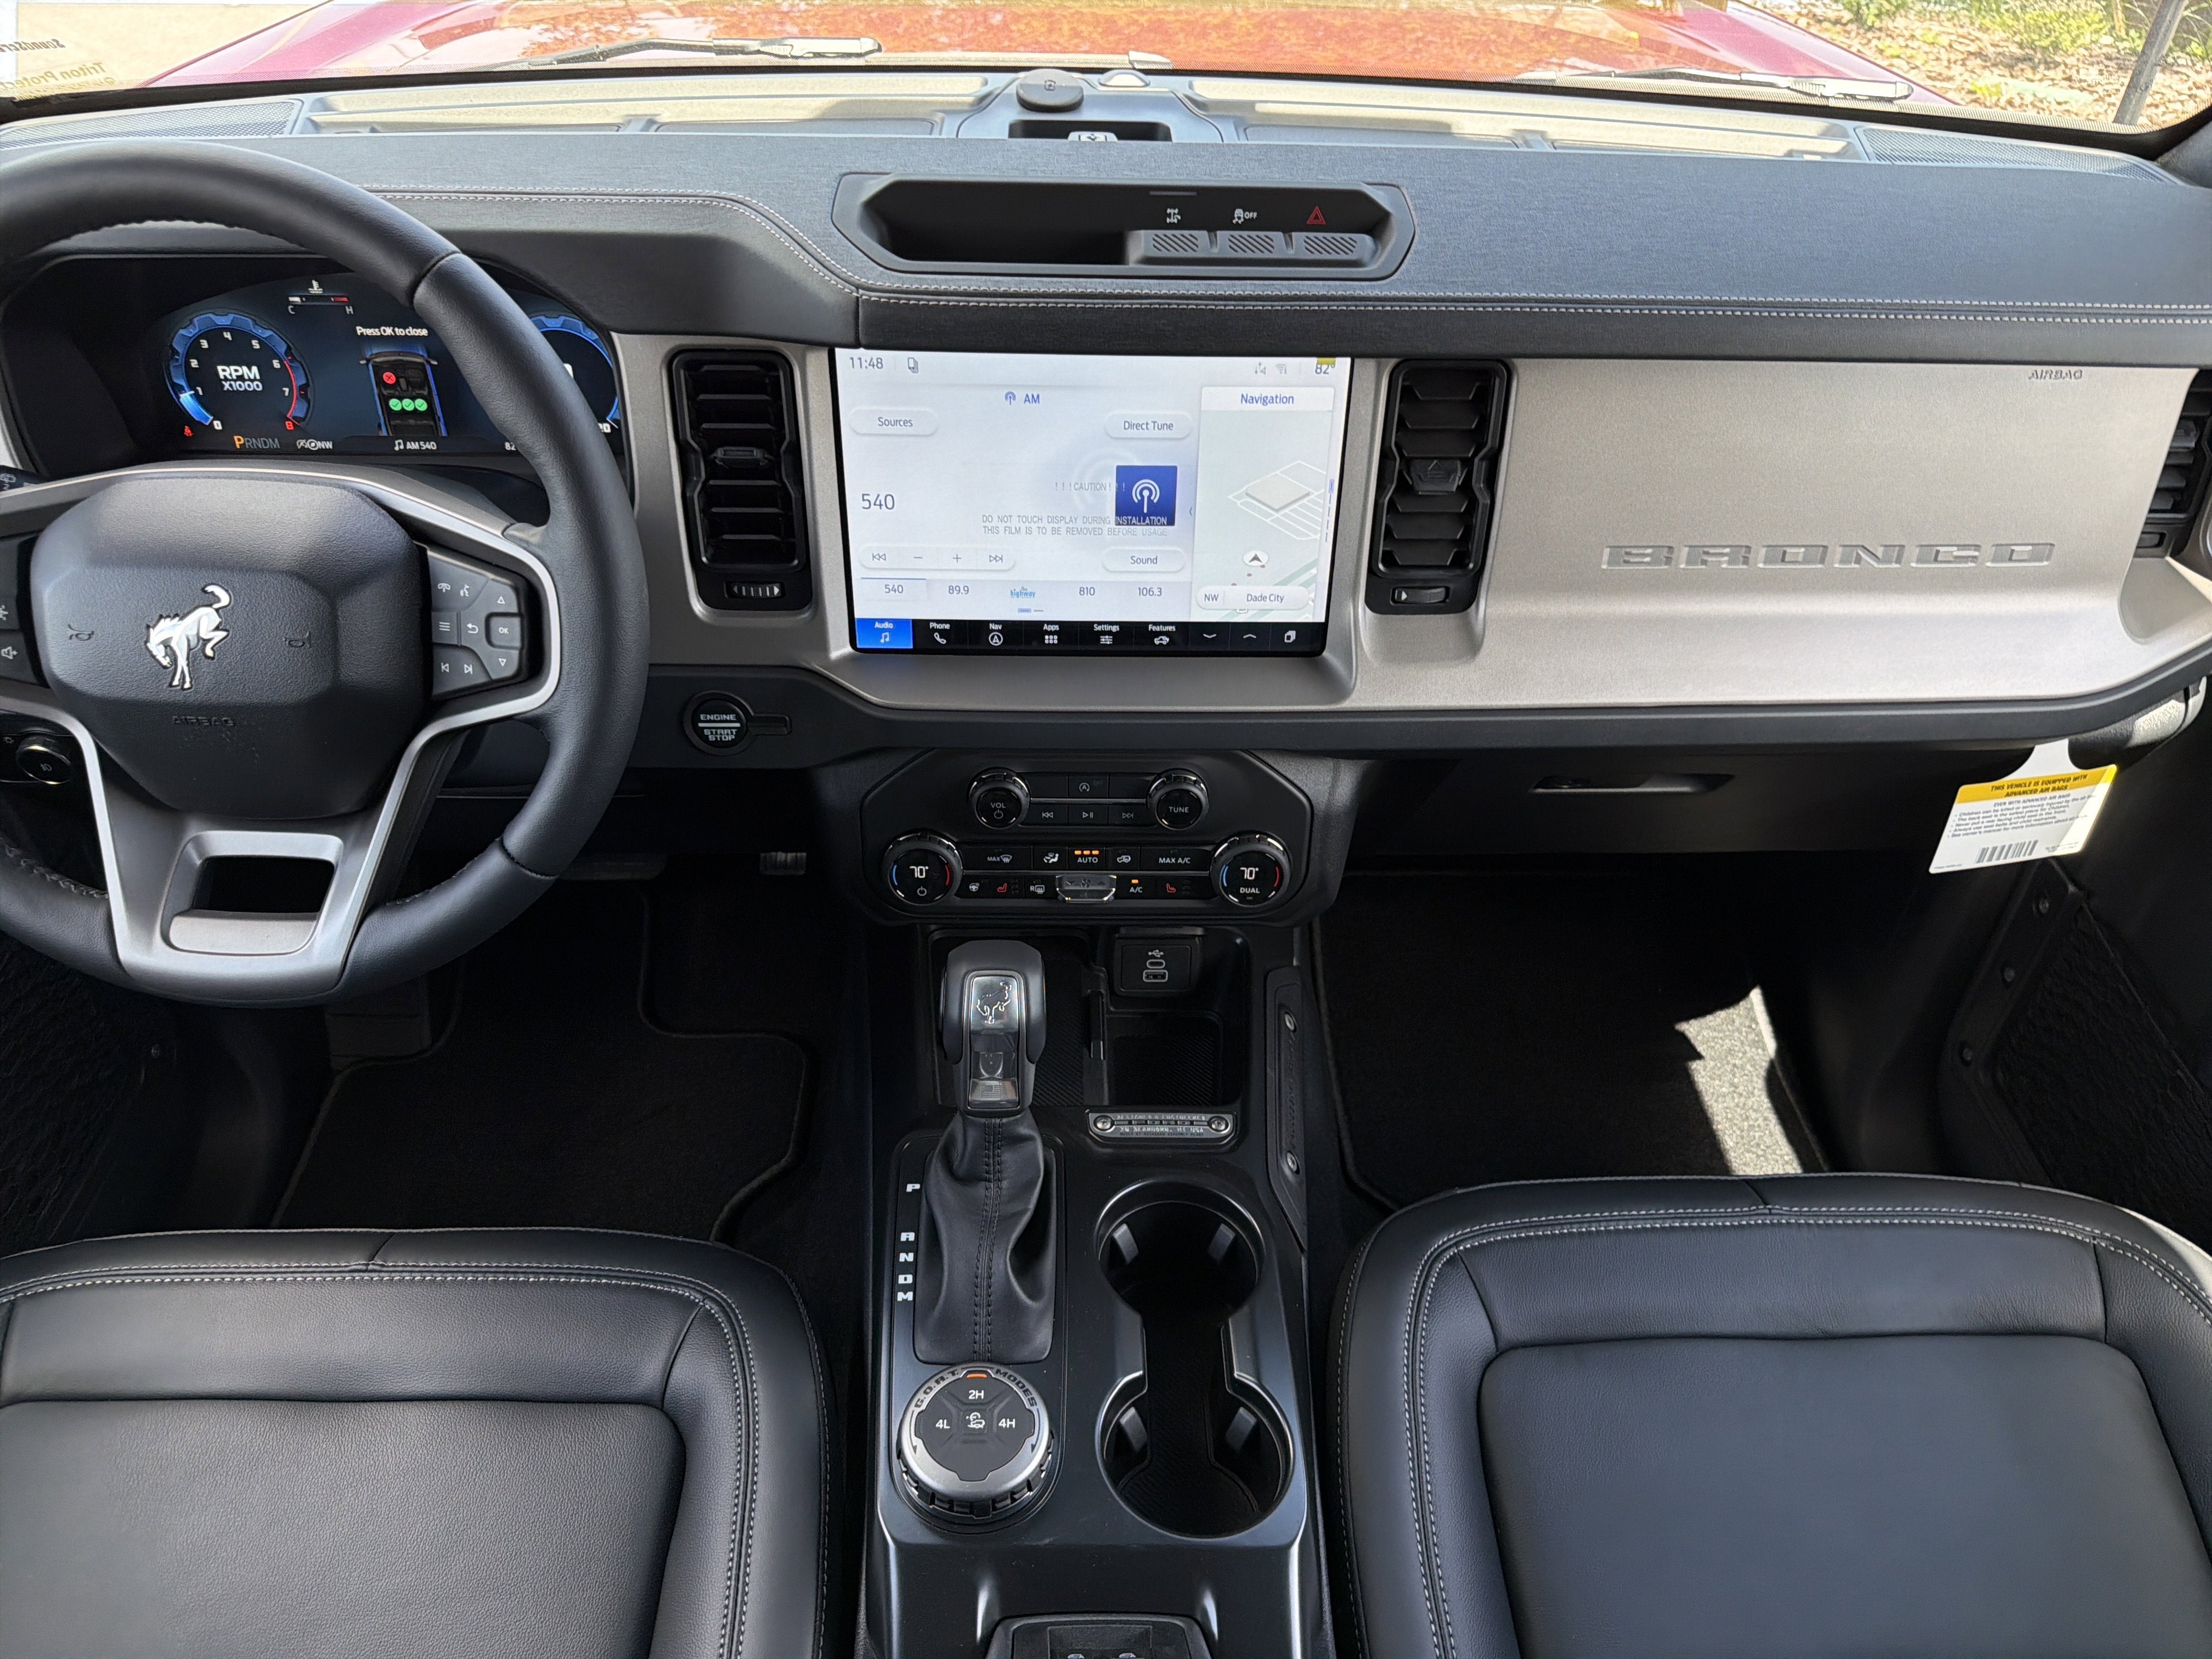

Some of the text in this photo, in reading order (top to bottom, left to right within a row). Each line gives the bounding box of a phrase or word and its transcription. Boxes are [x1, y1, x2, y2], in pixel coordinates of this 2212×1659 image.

[287, 305, 296, 314] C
[345, 305, 354, 315] H
[222, 331, 233, 341] 4
[356, 326, 428, 336] Press OK to close
[199, 340, 209, 348] 3
[251, 340, 261, 349] 5
[189, 359, 200, 368] 2
[272, 359, 281, 369] 6
[849, 357, 884, 369] 11:48
[217, 365, 261, 379] RPM
[2028, 369, 2083, 380] AIRBAG
[196, 386, 204, 396] 1
[282, 387, 290, 397] 7
[1024, 393, 1040, 404] AM
[1240, 393, 1294, 406] Navigation
[213, 420, 223, 430] 0
[877, 416, 913, 427] Sources
[1123, 421, 1173, 431] Direct Tune
[318, 441, 333, 450] NW
[406, 441, 437, 450] AM 540
[1074, 482, 1107, 492] CAUTION
[861, 493, 895, 511] 540
[982, 515, 1167, 526] DO NOT TOUCH DISPLAY DURING INSTALLATION
[983, 526, 1167, 536] THIS FILM IS TO BE REMOVED BEFORE USAGE
[1129, 555, 1158, 566] Sound
[1600, 542, 2057, 569] BRONCO
[884, 584, 904, 594] 540
[948, 585, 969, 595] 89.9
[1010, 589, 1036, 599] highway
[1079, 586, 1096, 596] 810
[1138, 587, 1163, 597] 106.3
[1204, 593, 1284, 603] NW Dade City
[1043, 623, 1059, 631] Apps
[1093, 623, 1120, 632] Settings
[906, 1183, 921, 1192] P
[899, 1252, 914, 1262] N
[898, 1274, 913, 1284] D
[897, 1291, 913, 1301] M
[995, 1368, 1037, 1407] MODES
[968, 1390, 984, 1400] 2H
[935, 1419, 951, 1429] 4L
[998, 1418, 1015, 1429] 4H
